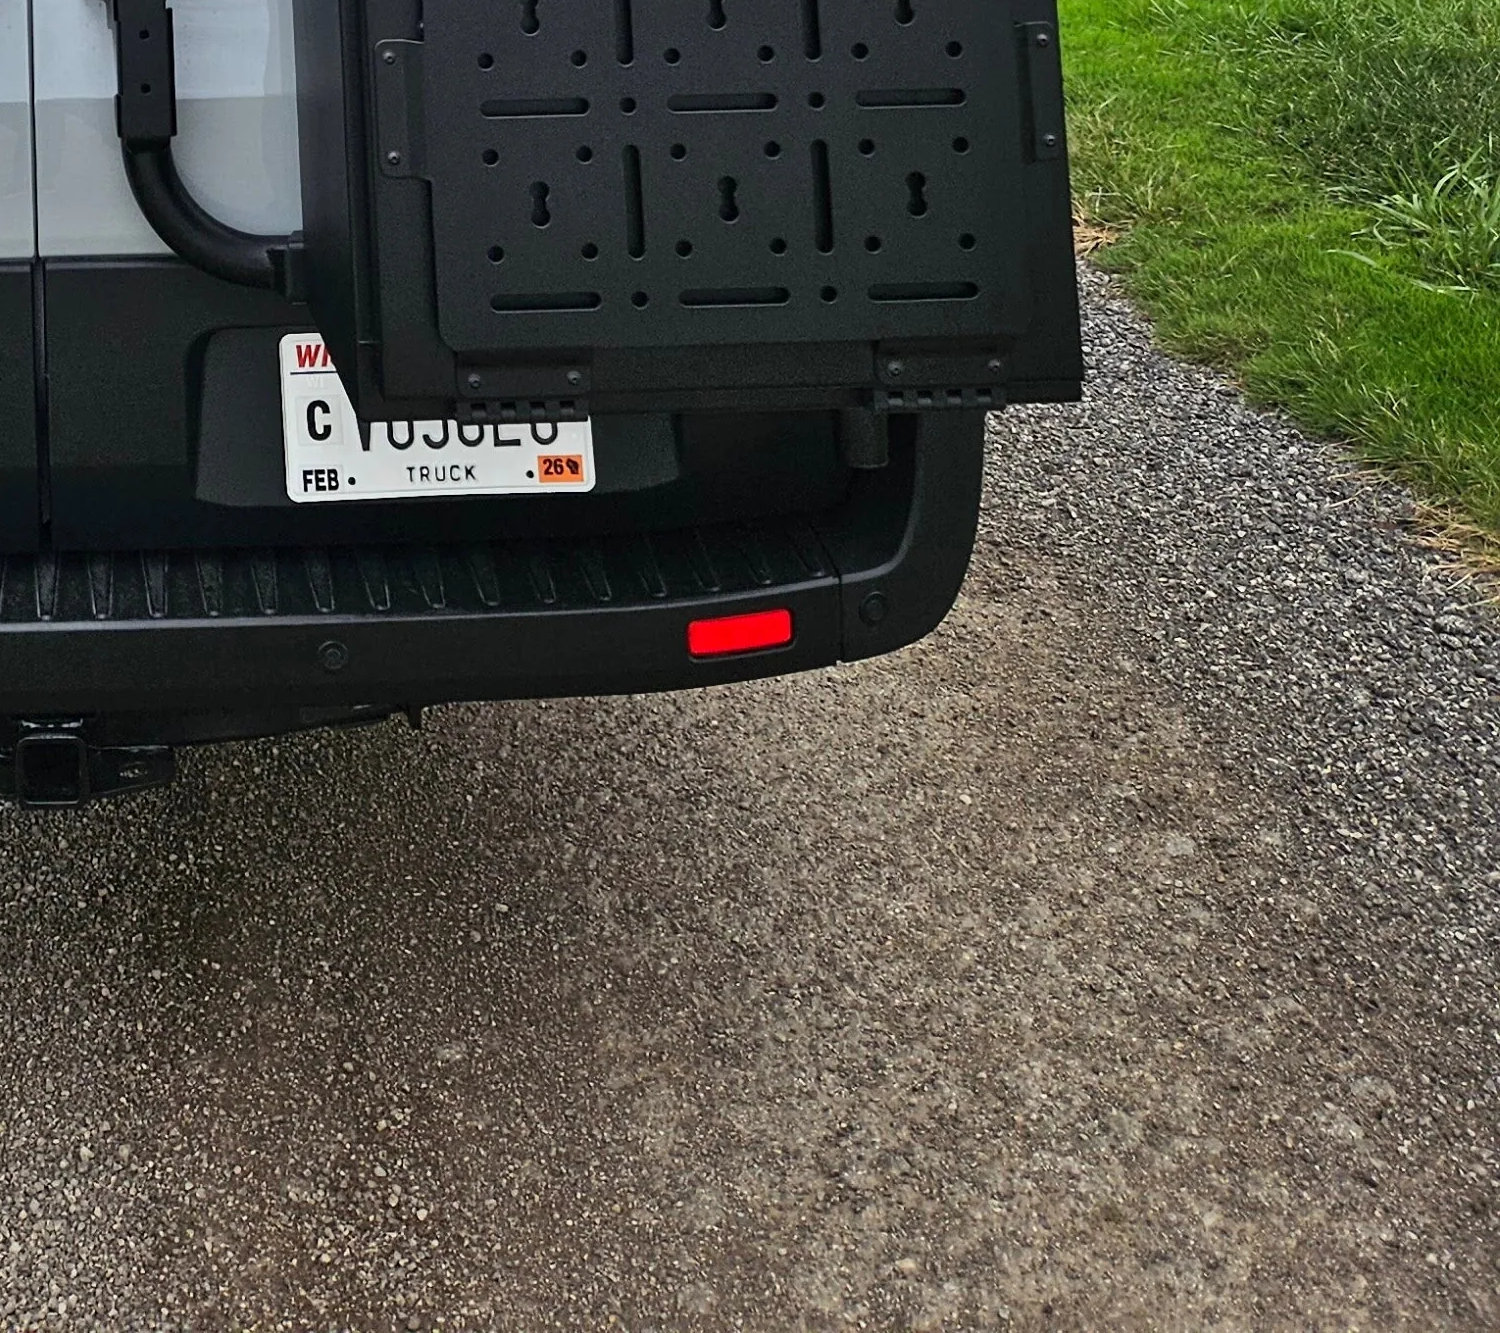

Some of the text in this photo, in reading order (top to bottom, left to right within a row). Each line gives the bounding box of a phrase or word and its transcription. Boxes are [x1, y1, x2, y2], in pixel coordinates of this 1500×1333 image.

[306, 399, 332, 441] C
[302, 458, 564, 493] FEB TRUCK 26
